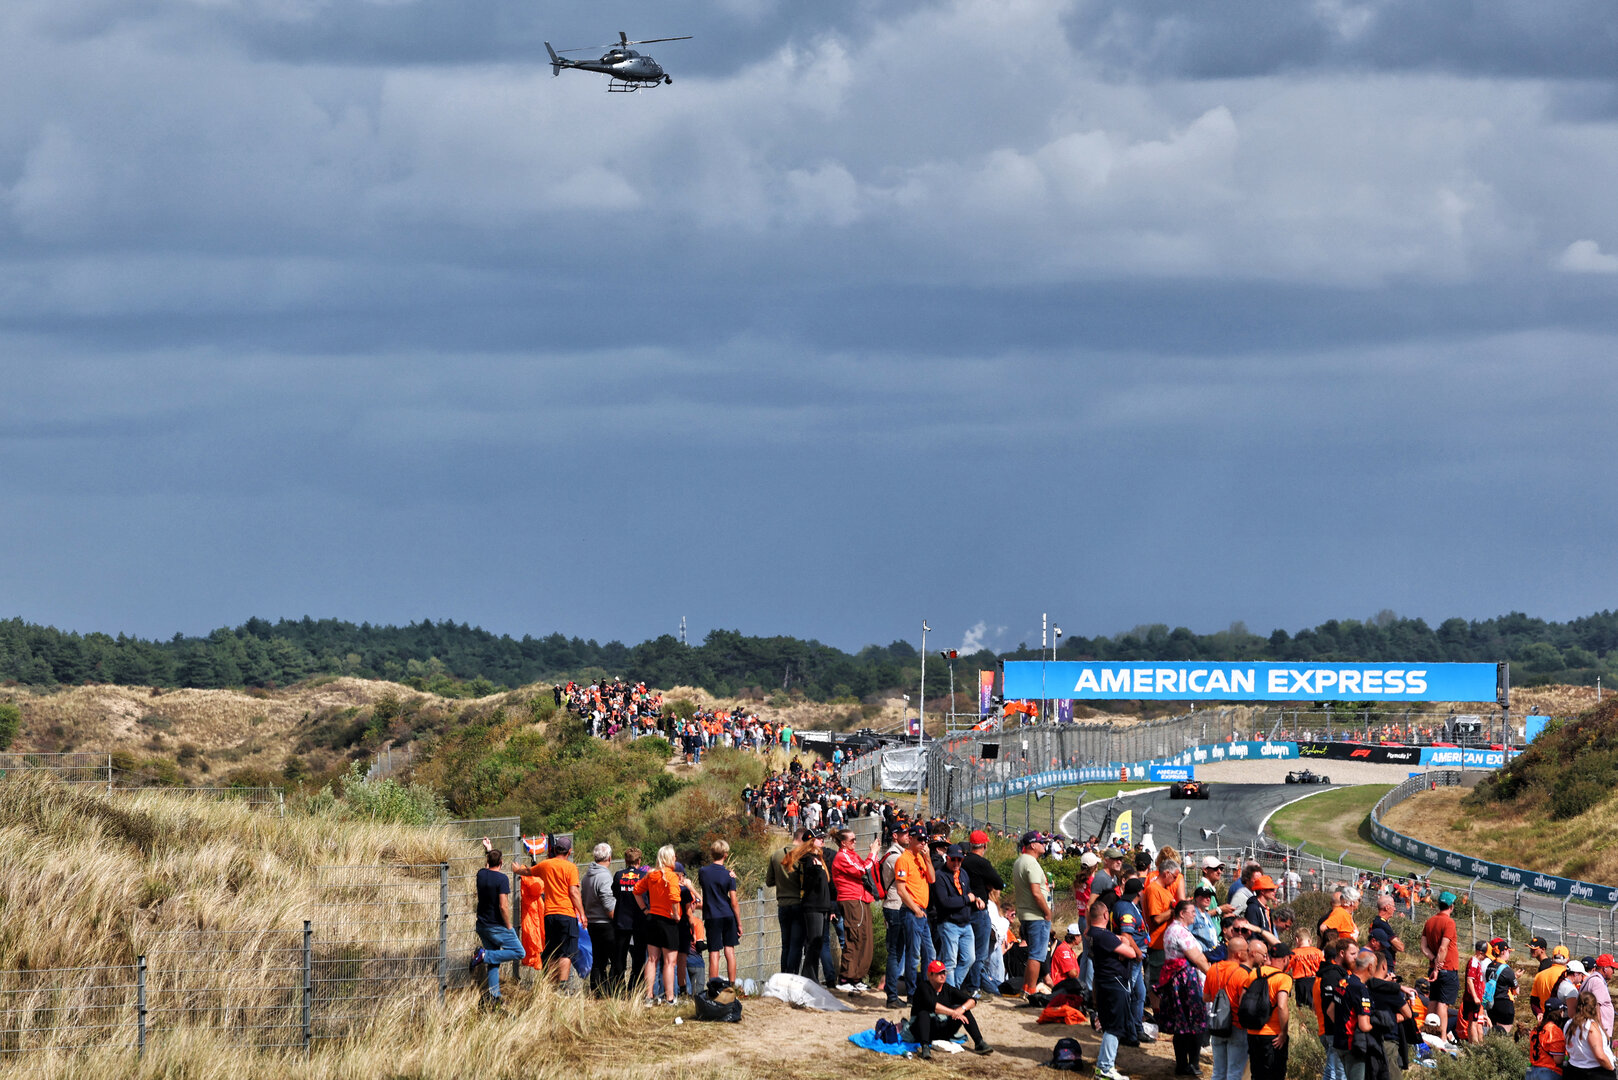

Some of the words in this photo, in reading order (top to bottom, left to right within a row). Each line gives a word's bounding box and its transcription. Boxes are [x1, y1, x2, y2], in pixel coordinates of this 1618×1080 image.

[1074, 669, 1255, 693] AMERICAN
[1268, 669, 1428, 694] EXPRESS
[1261, 742, 1289, 759] allwyn
[1500, 868, 1521, 885] allwyn
[1534, 875, 1557, 892] allwyn
[1570, 881, 1593, 899] allwyn
